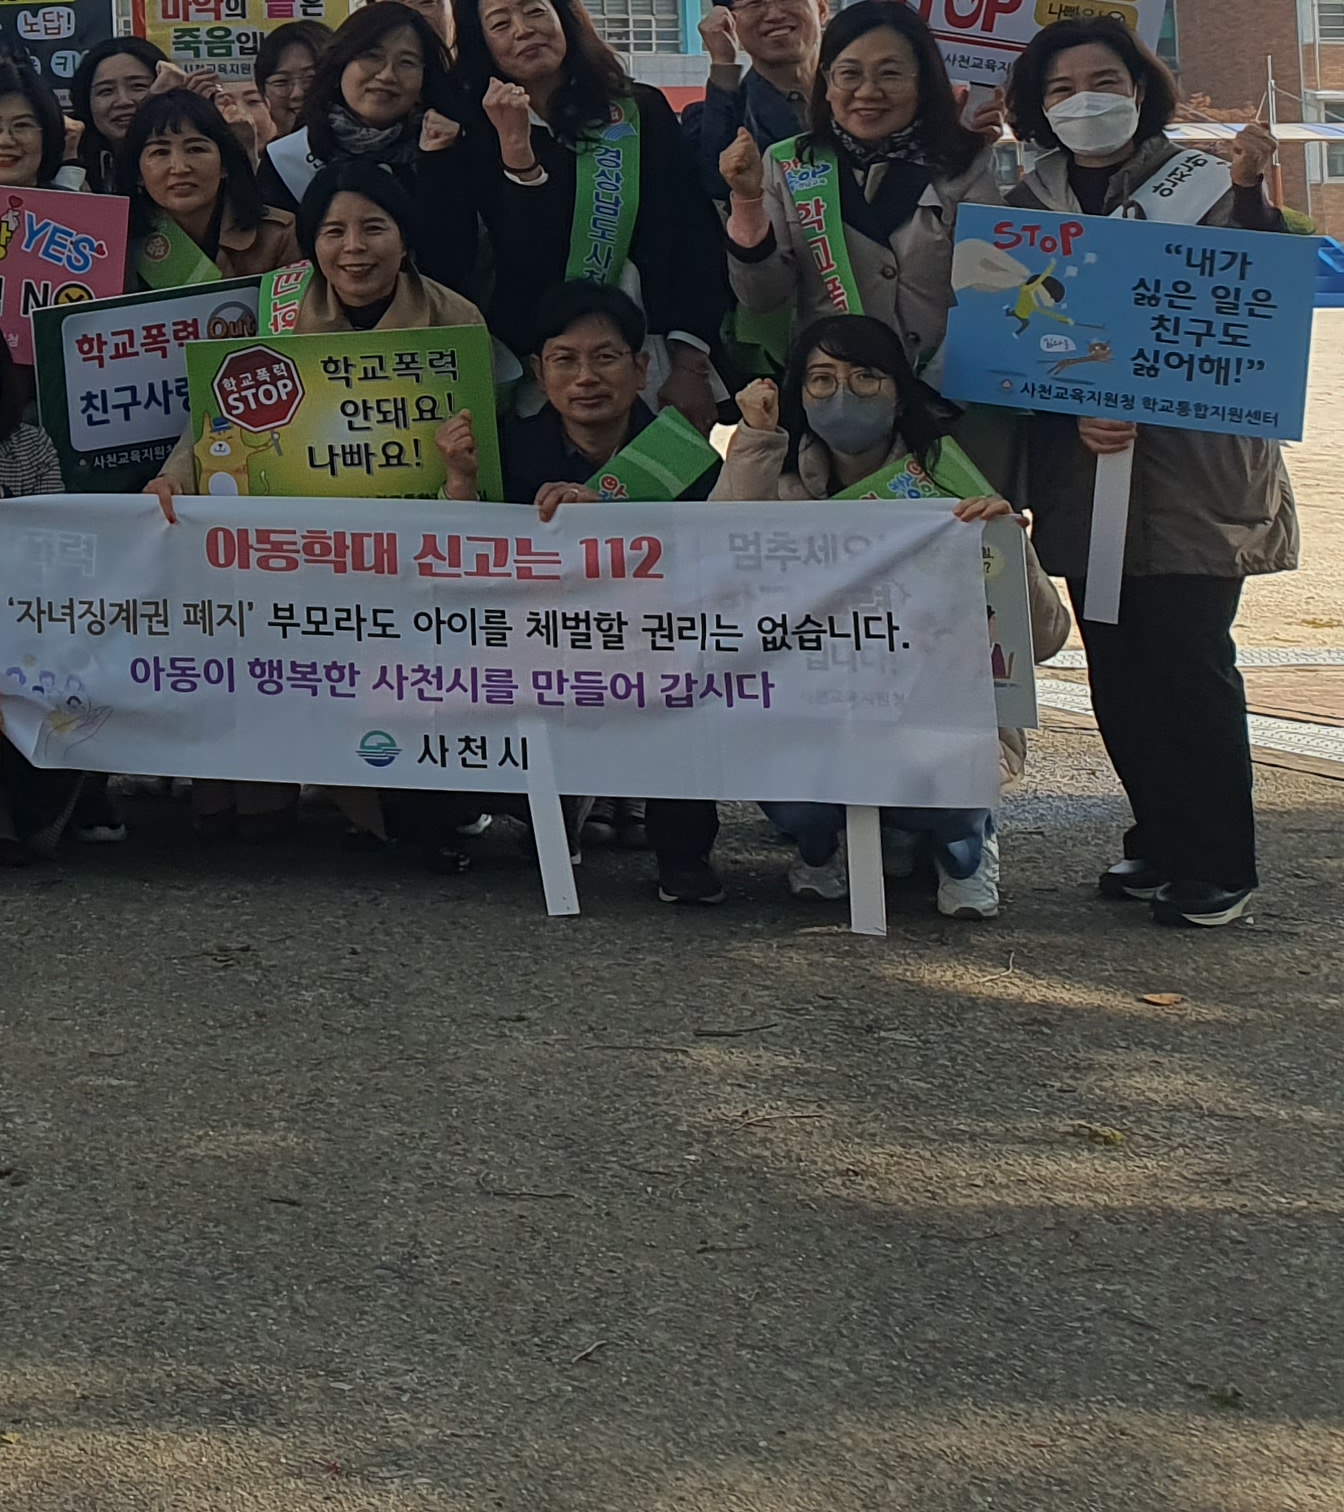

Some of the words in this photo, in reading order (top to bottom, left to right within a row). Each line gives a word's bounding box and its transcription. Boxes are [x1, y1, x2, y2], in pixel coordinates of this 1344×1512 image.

[23, 11, 72, 36] 노답!
[172, 25, 265, 59] 죽음입
[183, 63, 256, 76] 사천교육지원
[20, 209, 98, 274] YES
[992, 220, 1085, 256] STOP
[1131, 276, 1198, 311] 싫은
[1211, 284, 1279, 320] 일은
[75, 317, 201, 370] 학교폭력
[1150, 312, 1253, 349] 친구도
[220, 362, 287, 393] 학교폭력
[319, 348, 459, 388] 학교폭력
[226, 378, 294, 417] STOP
[338, 392, 455, 432] 안돼요!
[1020, 381, 1136, 410] 사천교육지원청
[1141, 395, 1280, 428] 학교통합지원센터
[307, 437, 423, 478] 나빠요!
[204, 524, 399, 577] 아동학대
[412, 532, 563, 582] 신고는
[578, 534, 665, 581] 112
[266, 601, 402, 642] 부모라도
[412, 607, 513, 648] 아이를
[525, 610, 629, 653] 체벌할
[640, 611, 744, 653] 권리는
[756, 610, 911, 654] 없습니다.
[128, 656, 236, 694] 아동이
[246, 657, 361, 700] 행복한
[371, 661, 519, 706] 사천시를
[530, 670, 646, 708] 만들어
[660, 669, 776, 710] 갑시다
[415, 732, 531, 772] 사천시
